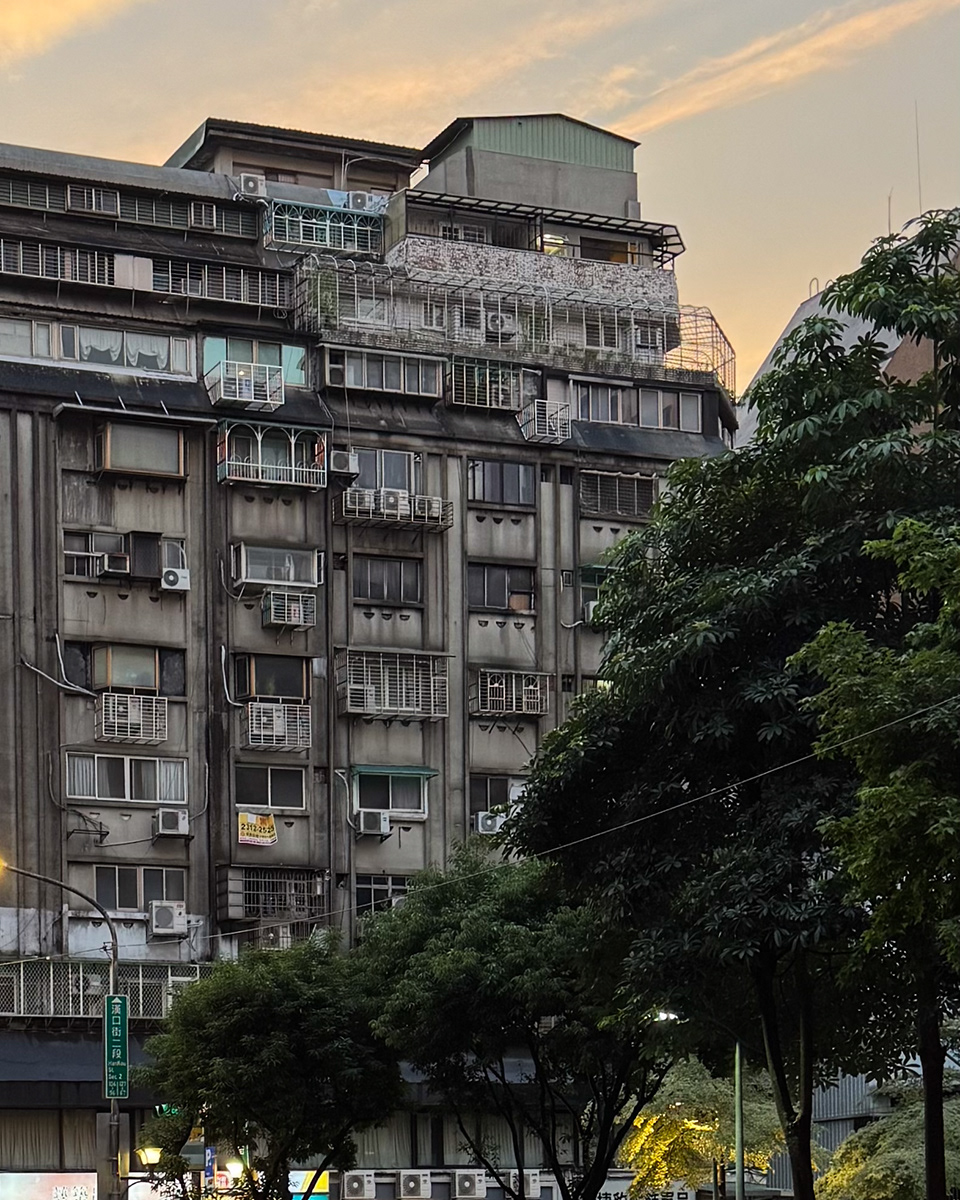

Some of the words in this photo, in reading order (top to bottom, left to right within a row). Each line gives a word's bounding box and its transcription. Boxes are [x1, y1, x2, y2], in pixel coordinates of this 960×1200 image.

[110, 1004, 123, 1059] 漢口街二段
